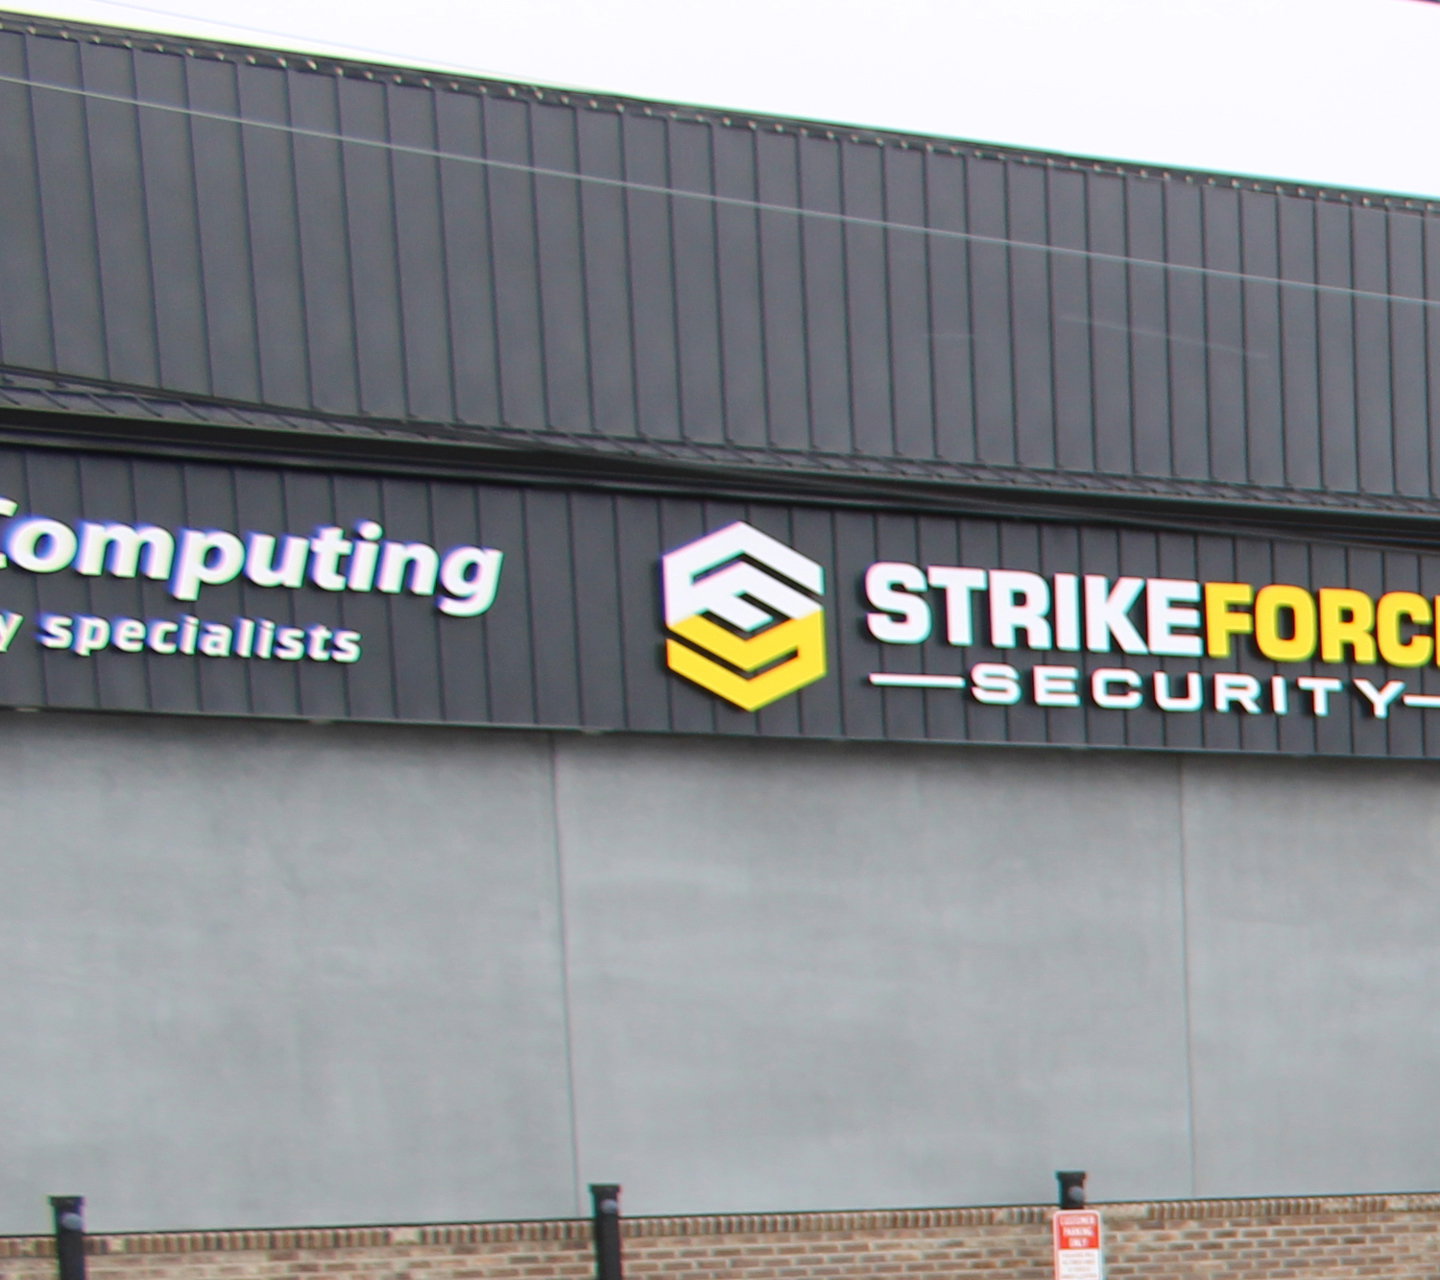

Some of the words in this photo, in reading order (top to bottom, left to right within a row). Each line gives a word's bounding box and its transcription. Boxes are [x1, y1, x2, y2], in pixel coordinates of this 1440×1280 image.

[0, 498, 502, 616] omputing
[41, 614, 361, 663] specialists
[970, 663, 1405, 719] SECURITY
